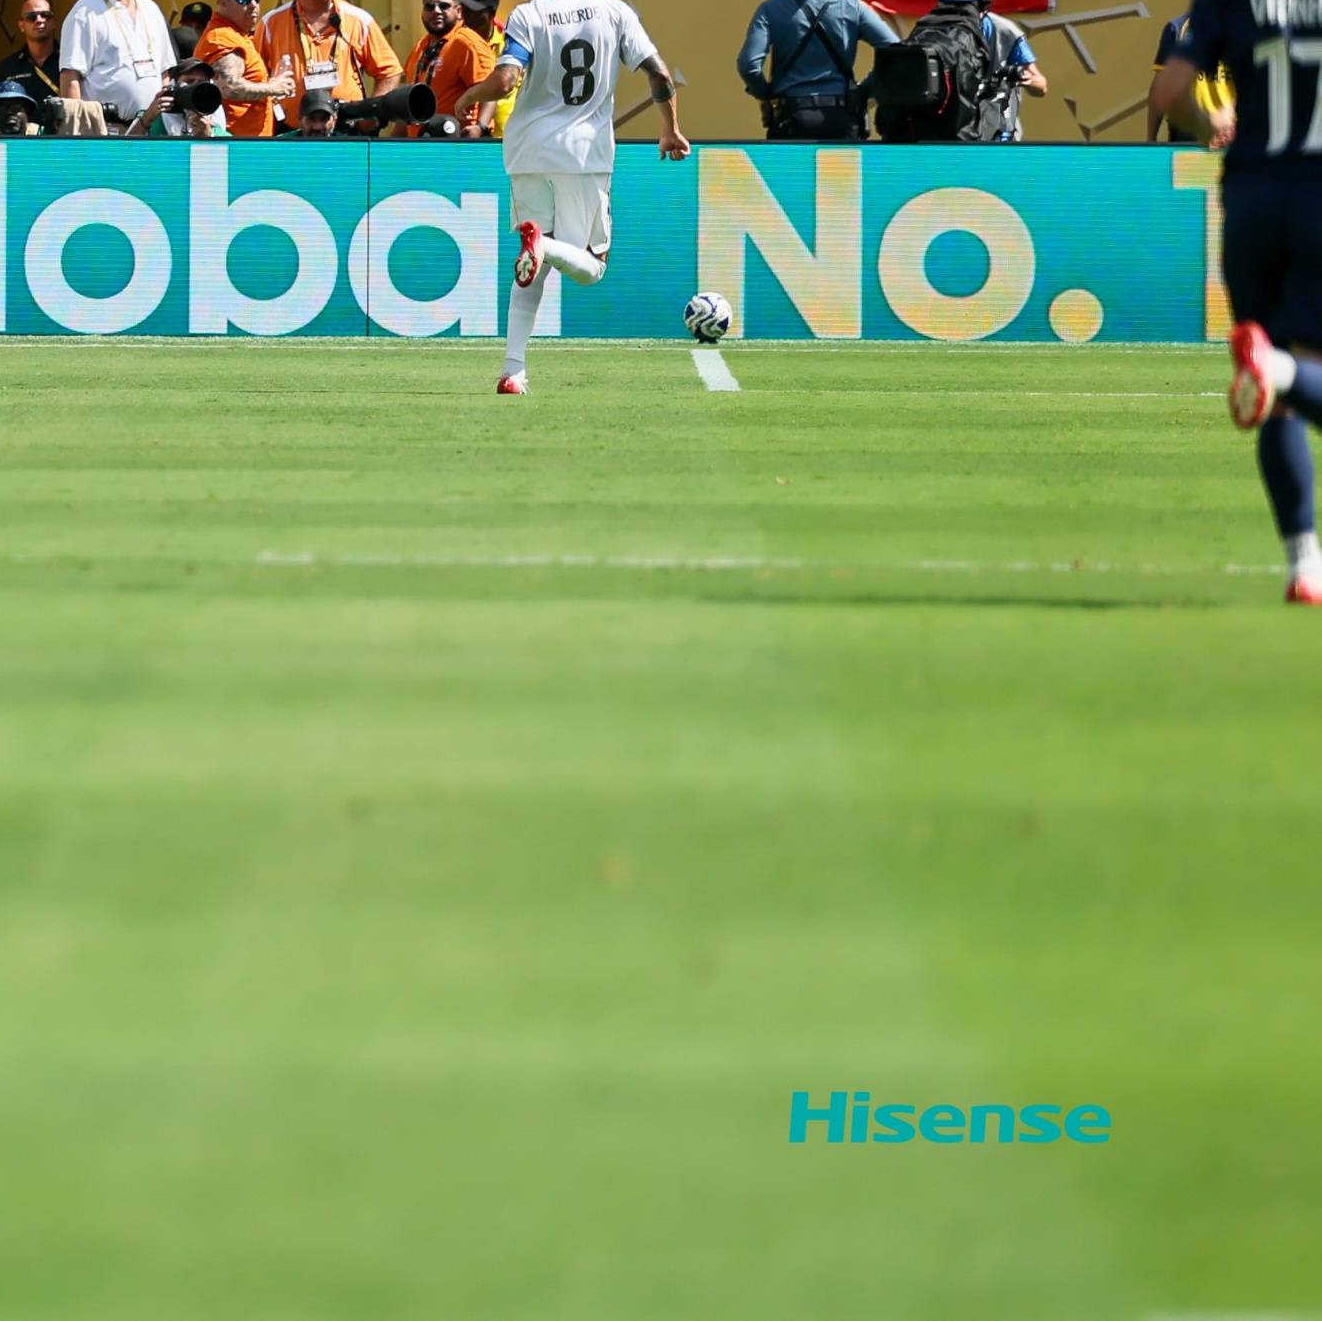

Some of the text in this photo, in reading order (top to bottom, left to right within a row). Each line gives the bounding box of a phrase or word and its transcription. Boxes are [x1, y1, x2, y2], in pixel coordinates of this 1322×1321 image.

[560, 38, 596, 106] 8
[1252, 36, 1322, 157] 17
[696, 148, 1104, 342] No.
